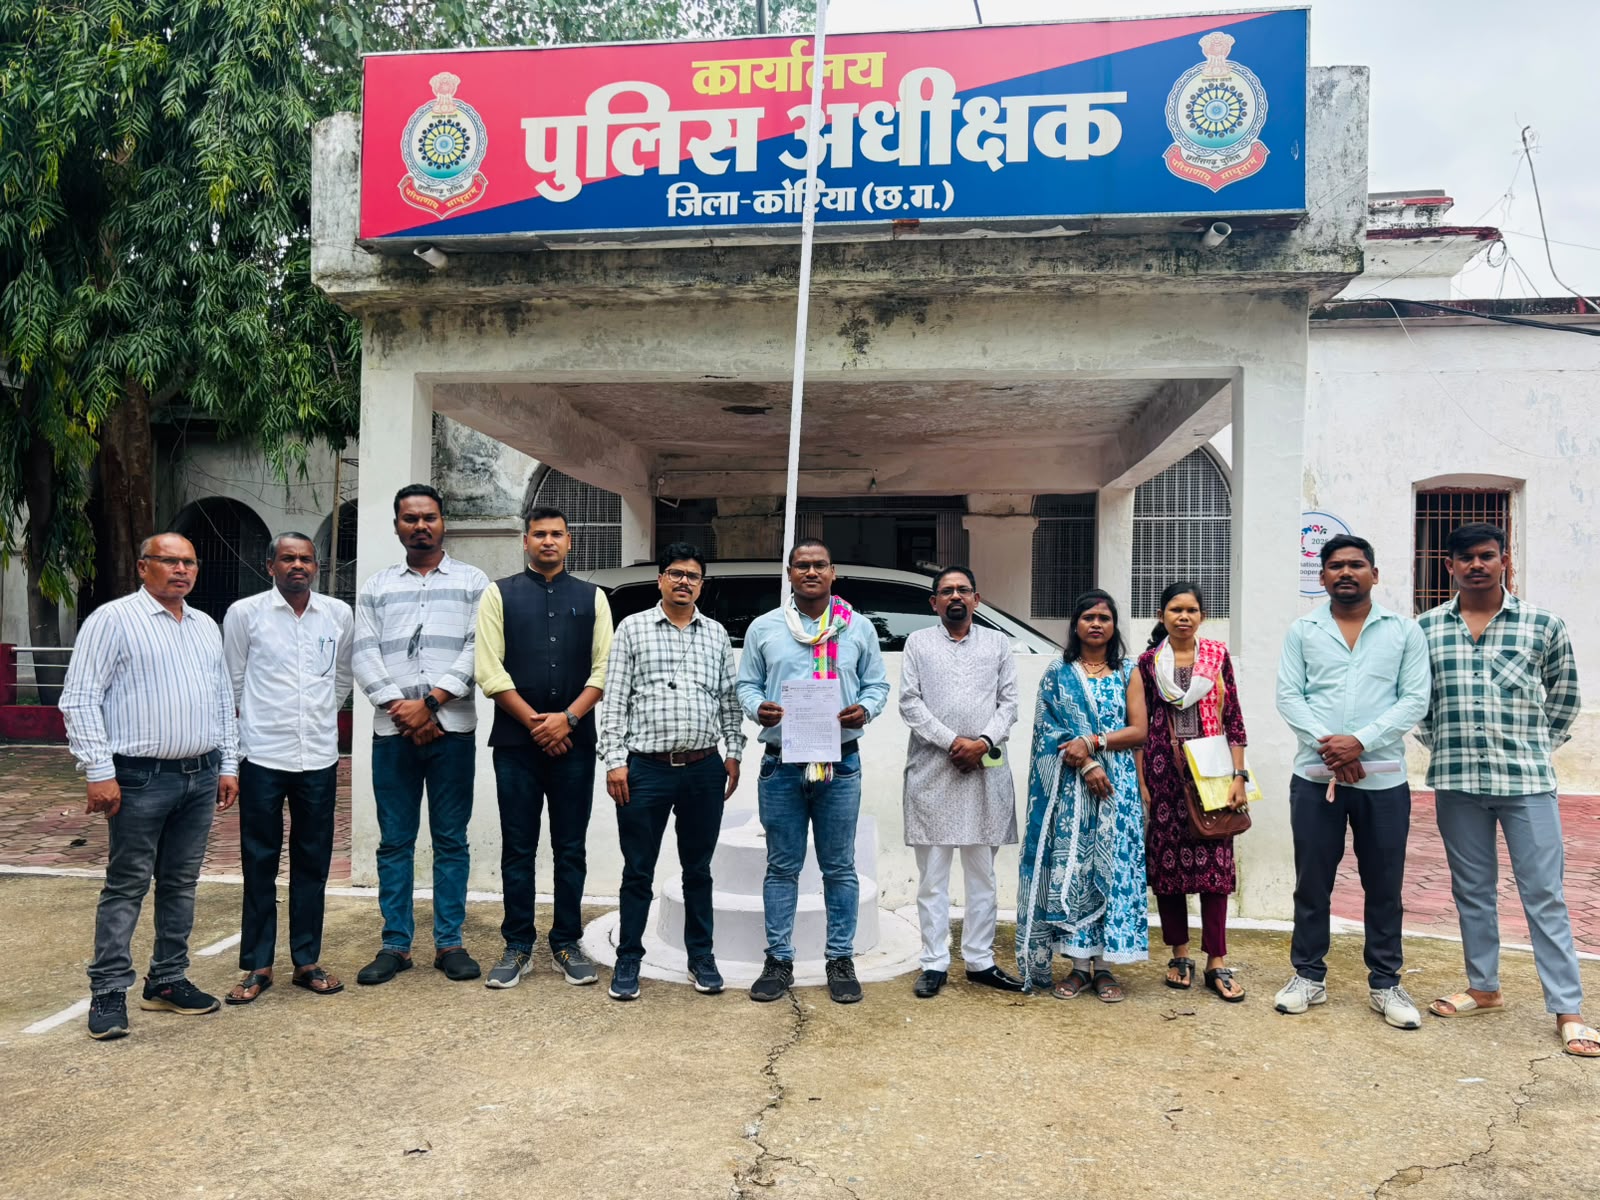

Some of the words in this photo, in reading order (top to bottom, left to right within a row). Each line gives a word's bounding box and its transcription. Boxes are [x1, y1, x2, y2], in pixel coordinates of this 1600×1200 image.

[692, 39, 887, 95] कार्यालय
[521, 81, 765, 202] पुलिस
[778, 67, 1127, 172] अधीक्षक
[861, 179, 955, 214] (छ.ग.)
